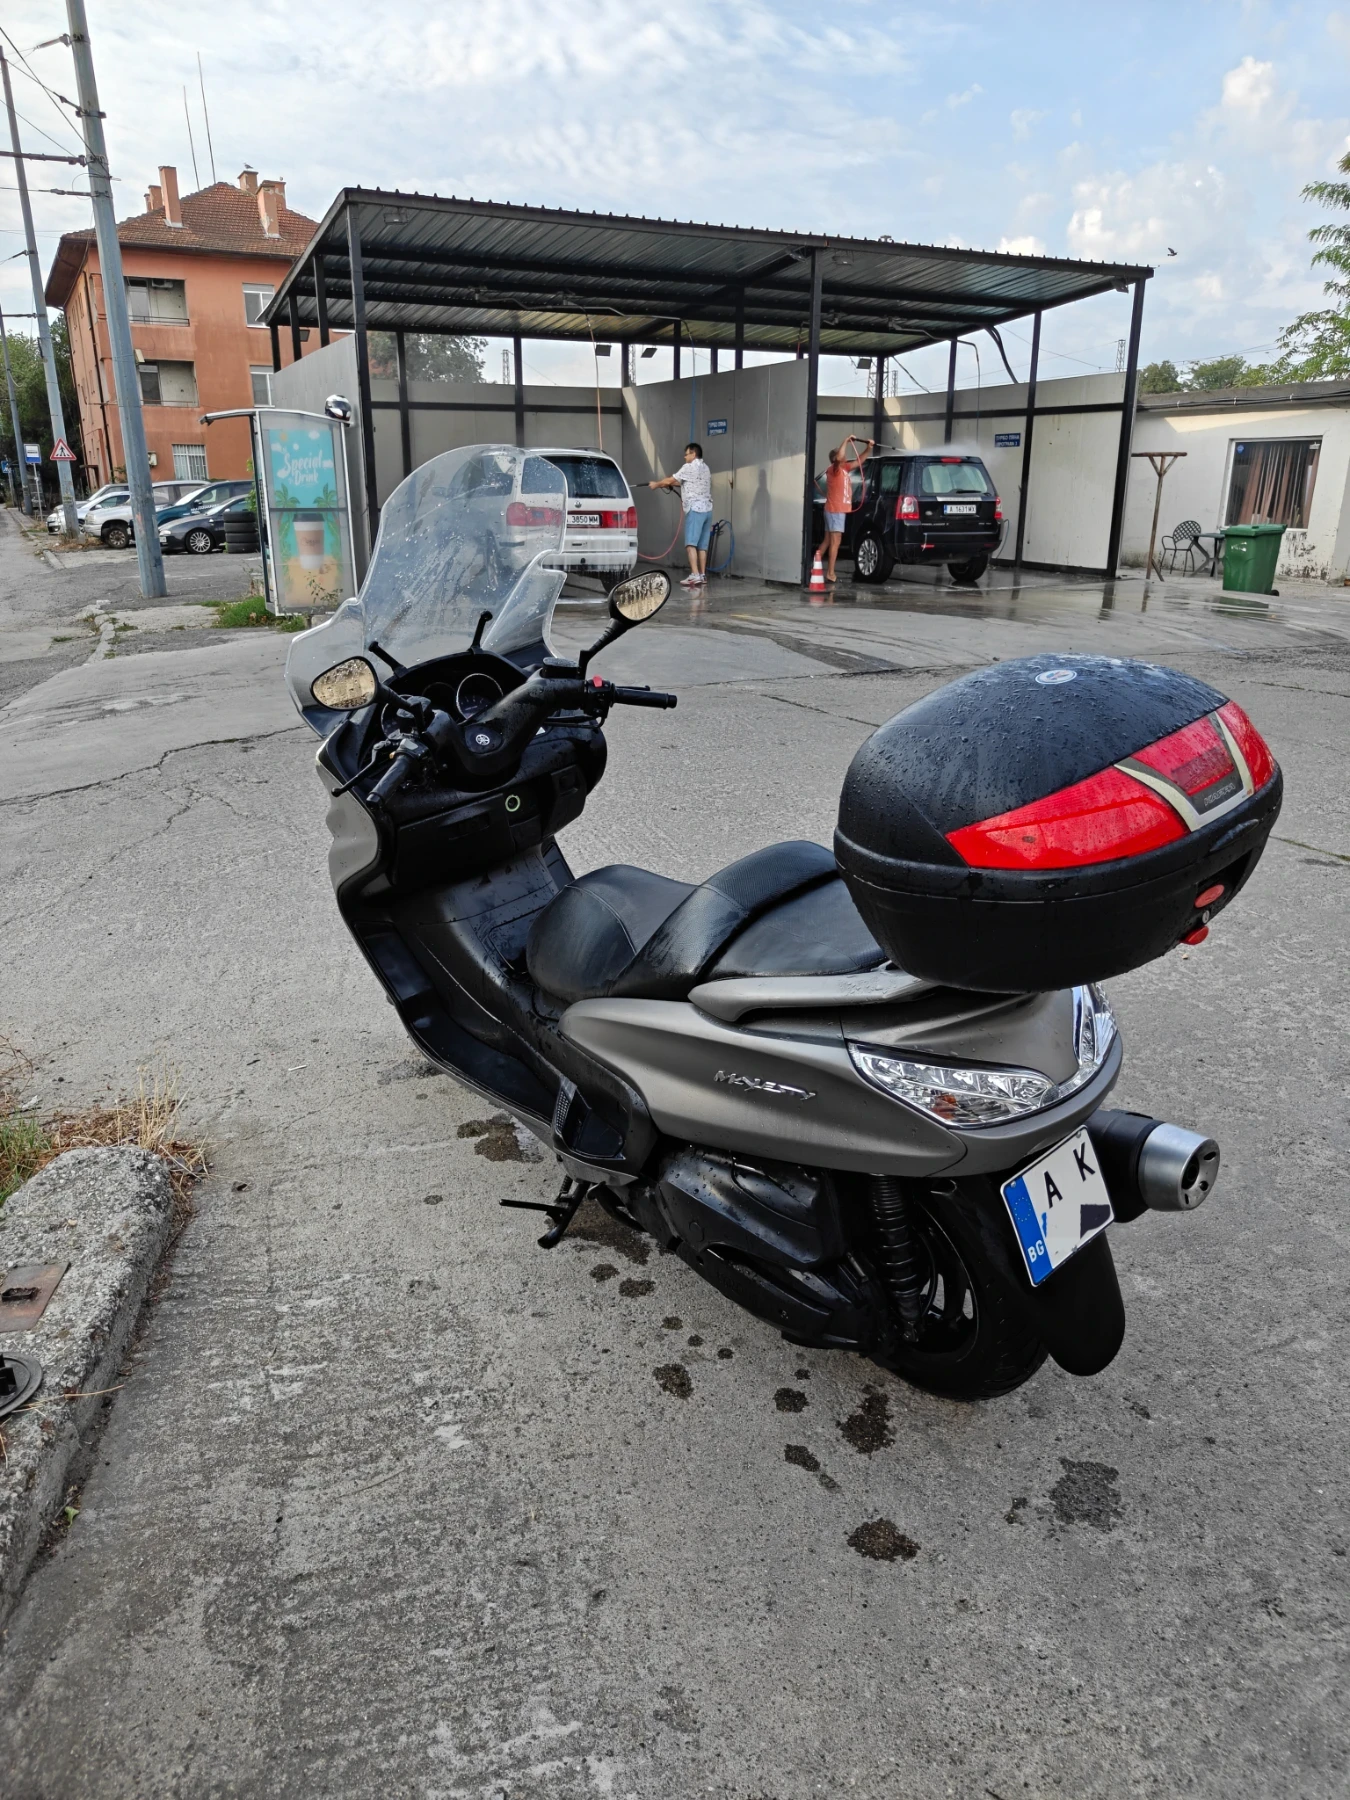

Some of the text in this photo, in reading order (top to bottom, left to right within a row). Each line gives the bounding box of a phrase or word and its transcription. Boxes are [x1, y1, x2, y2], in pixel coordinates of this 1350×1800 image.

[284, 450, 323, 476] Special
[294, 468, 319, 486] Drink
[1043, 1141, 1096, 1209] A K
[1027, 1240, 1045, 1263] BG
